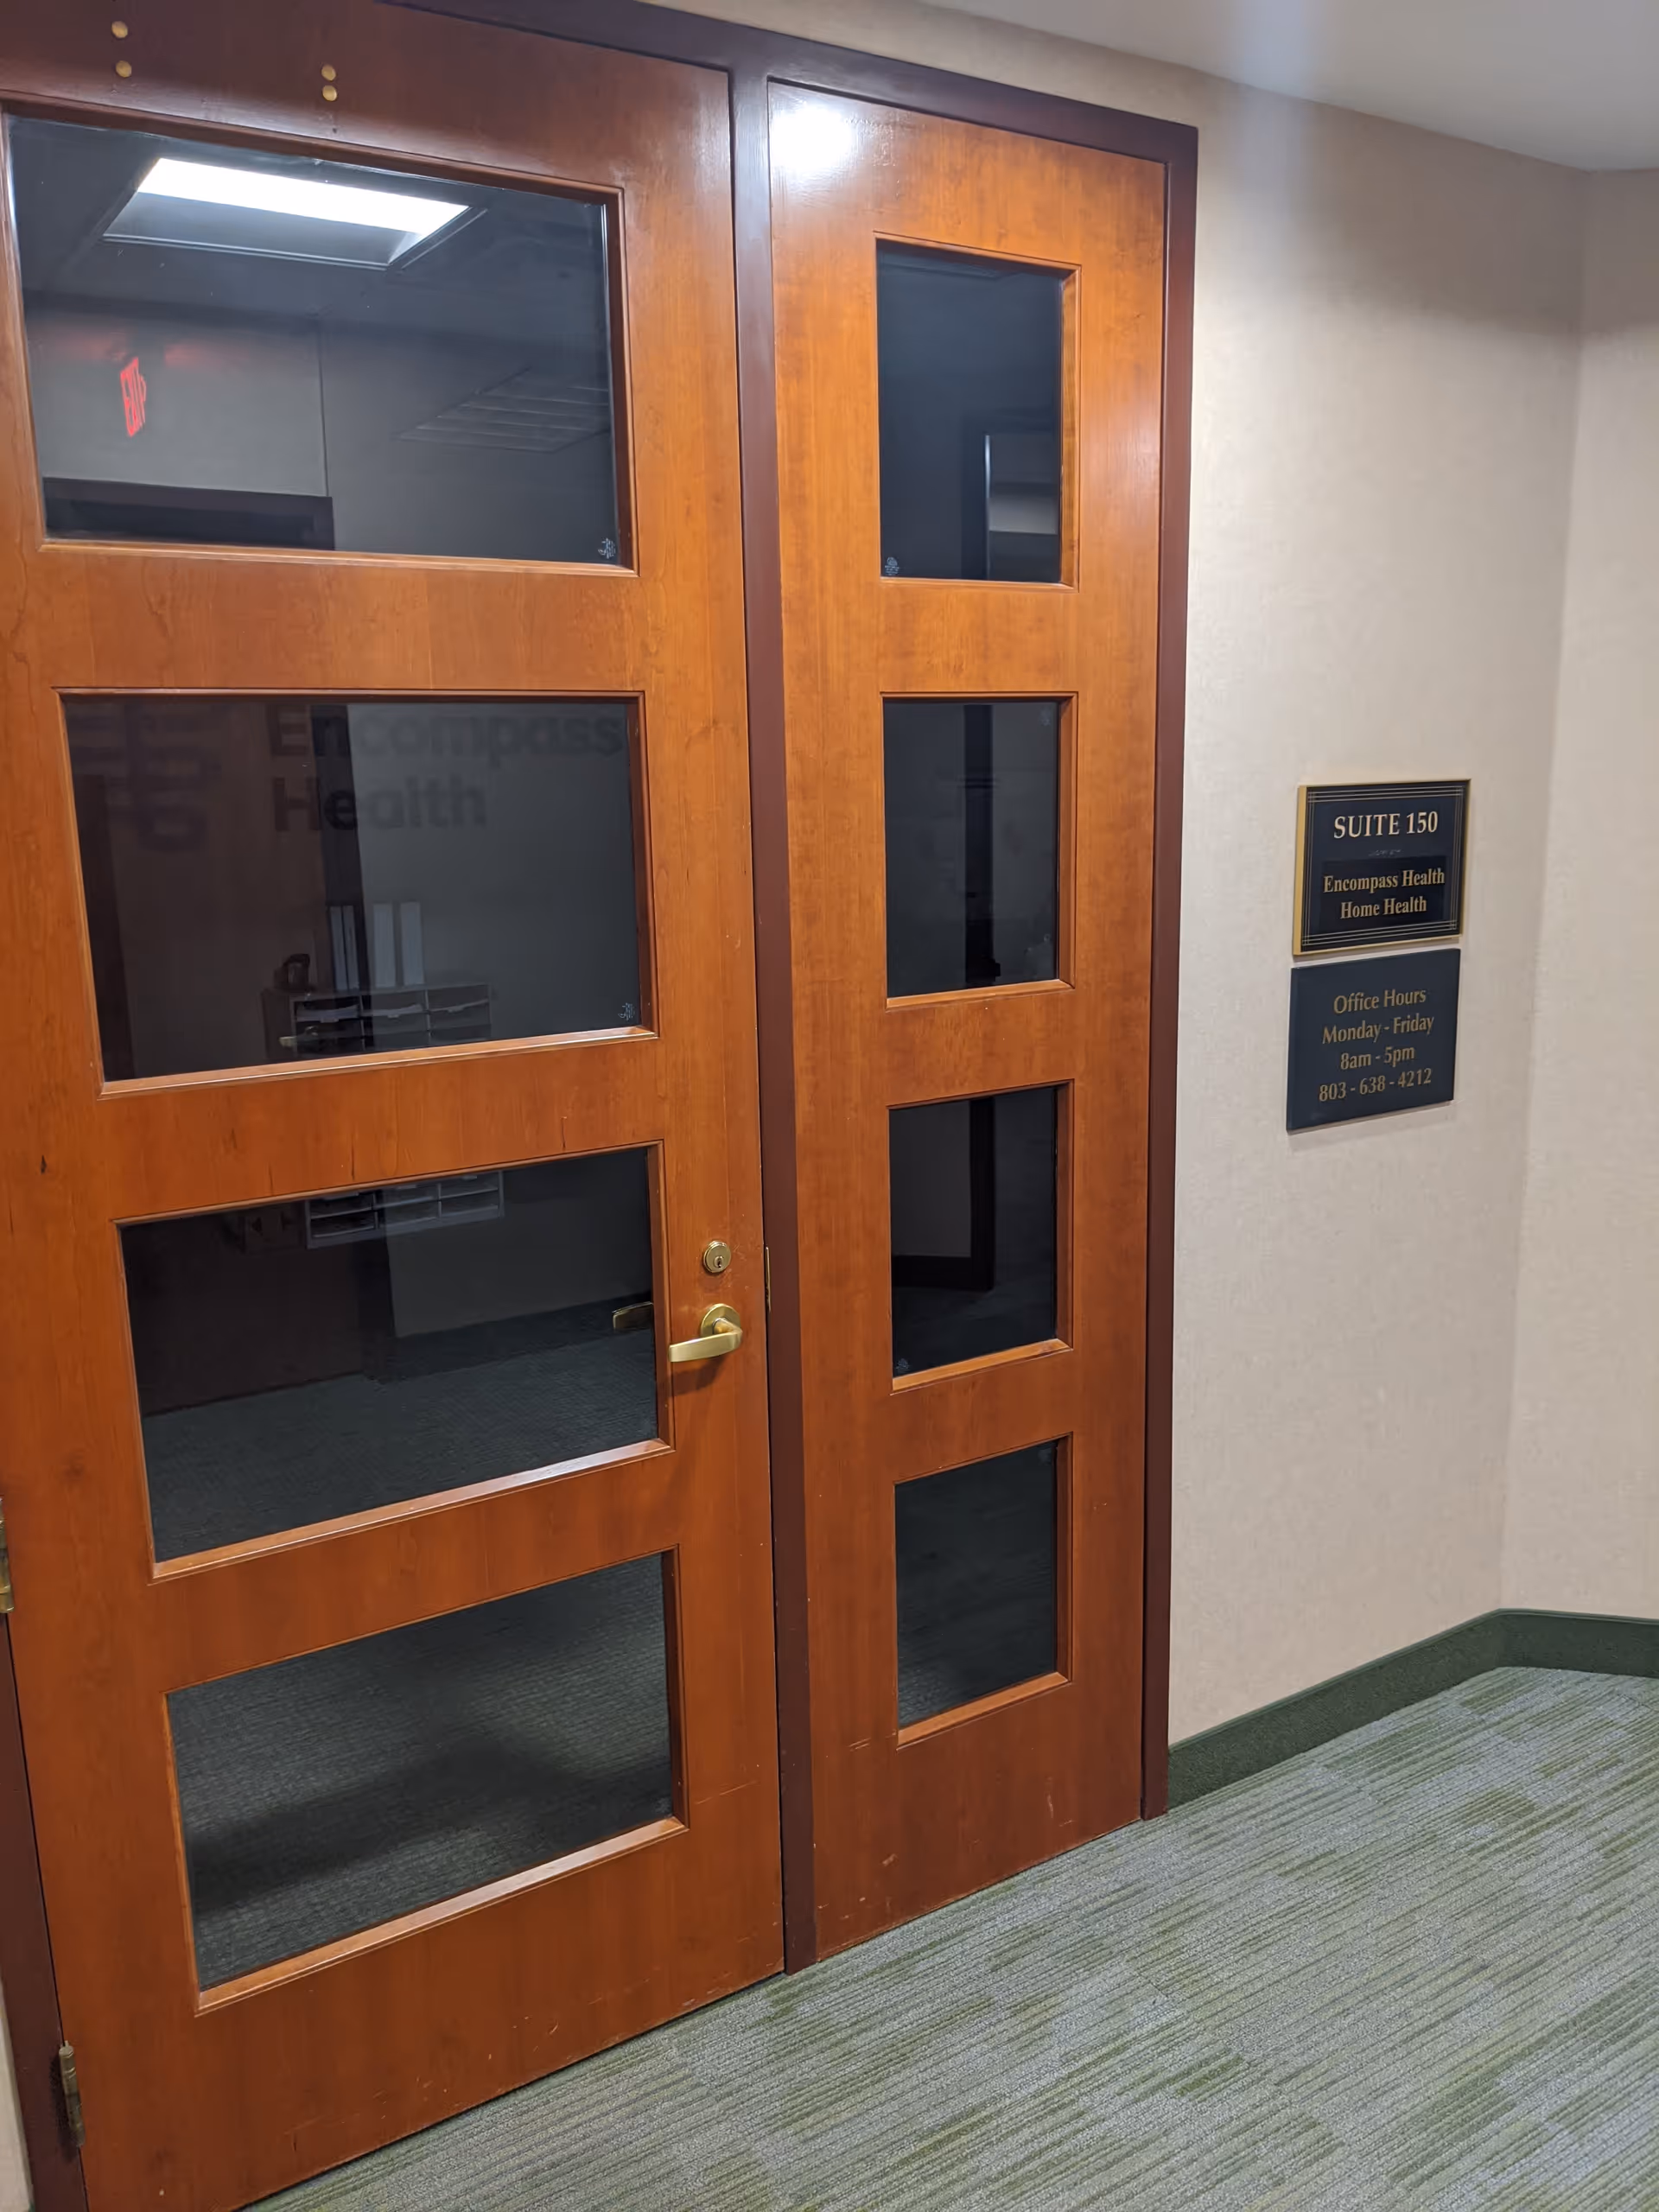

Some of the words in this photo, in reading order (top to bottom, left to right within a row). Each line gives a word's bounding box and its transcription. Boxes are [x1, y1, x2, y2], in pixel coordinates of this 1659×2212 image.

[270, 703, 624, 767] Encompass
[271, 776, 487, 831] Health
[1333, 813, 1401, 838] SUITE
[1406, 810, 1438, 834] 150
[1323, 875, 1398, 893] Encompass
[1402, 868, 1445, 887] Health
[1340, 901, 1380, 919] Home
[1382, 896, 1427, 915] Health
[1333, 992, 1379, 1014] Office
[1383, 989, 1426, 1007] Hours
[1322, 1020, 1382, 1043] Monday
[1393, 1013, 1434, 1035] Friday
[1340, 1052, 1371, 1070] 8am
[1383, 1046, 1414, 1067] 5pm
[1319, 1082, 1346, 1102] 803
[1359, 1076, 1386, 1095] 638
[1397, 1068, 1433, 1088] 4212
